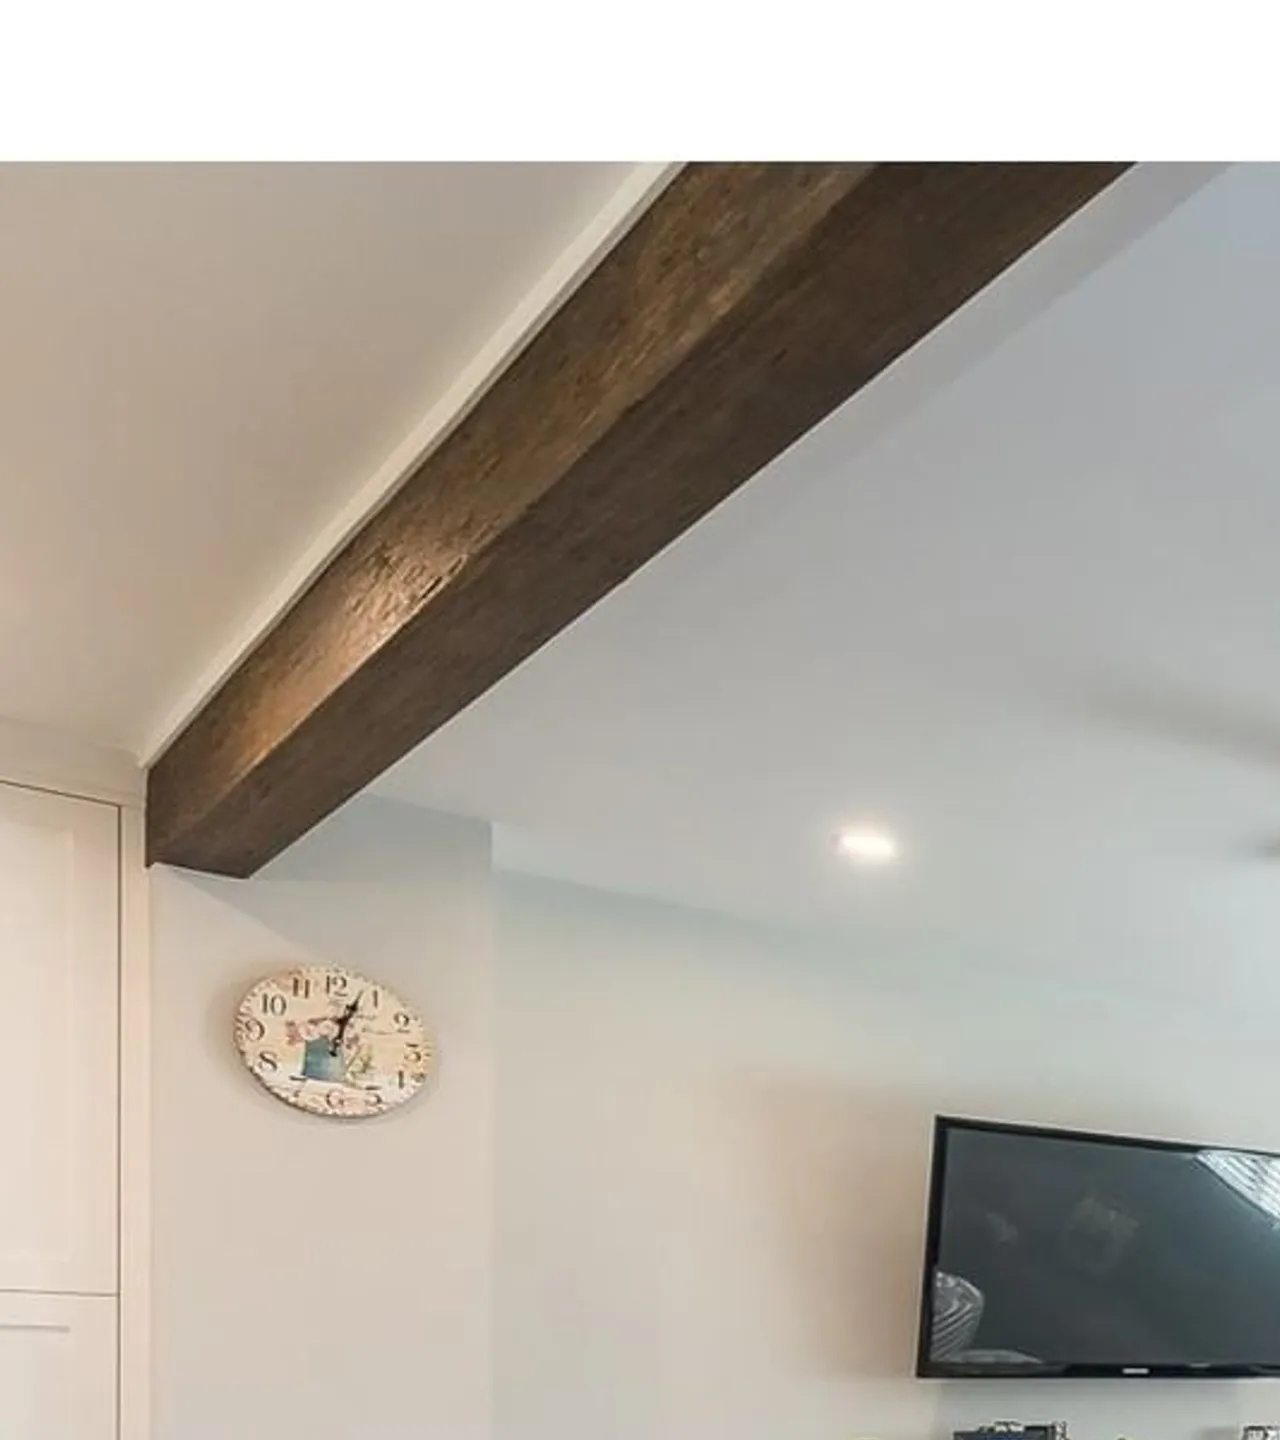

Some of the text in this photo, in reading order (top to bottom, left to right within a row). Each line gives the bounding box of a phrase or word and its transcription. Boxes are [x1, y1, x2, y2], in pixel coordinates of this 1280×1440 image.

[292, 976, 310, 999] 11
[326, 974, 348, 997] 12
[262, 992, 287, 1016] 10
[373, 989, 379, 1008] 1
[244, 1018, 265, 1041] 9
[394, 1011, 410, 1034] 2
[258, 1050, 278, 1072] 8
